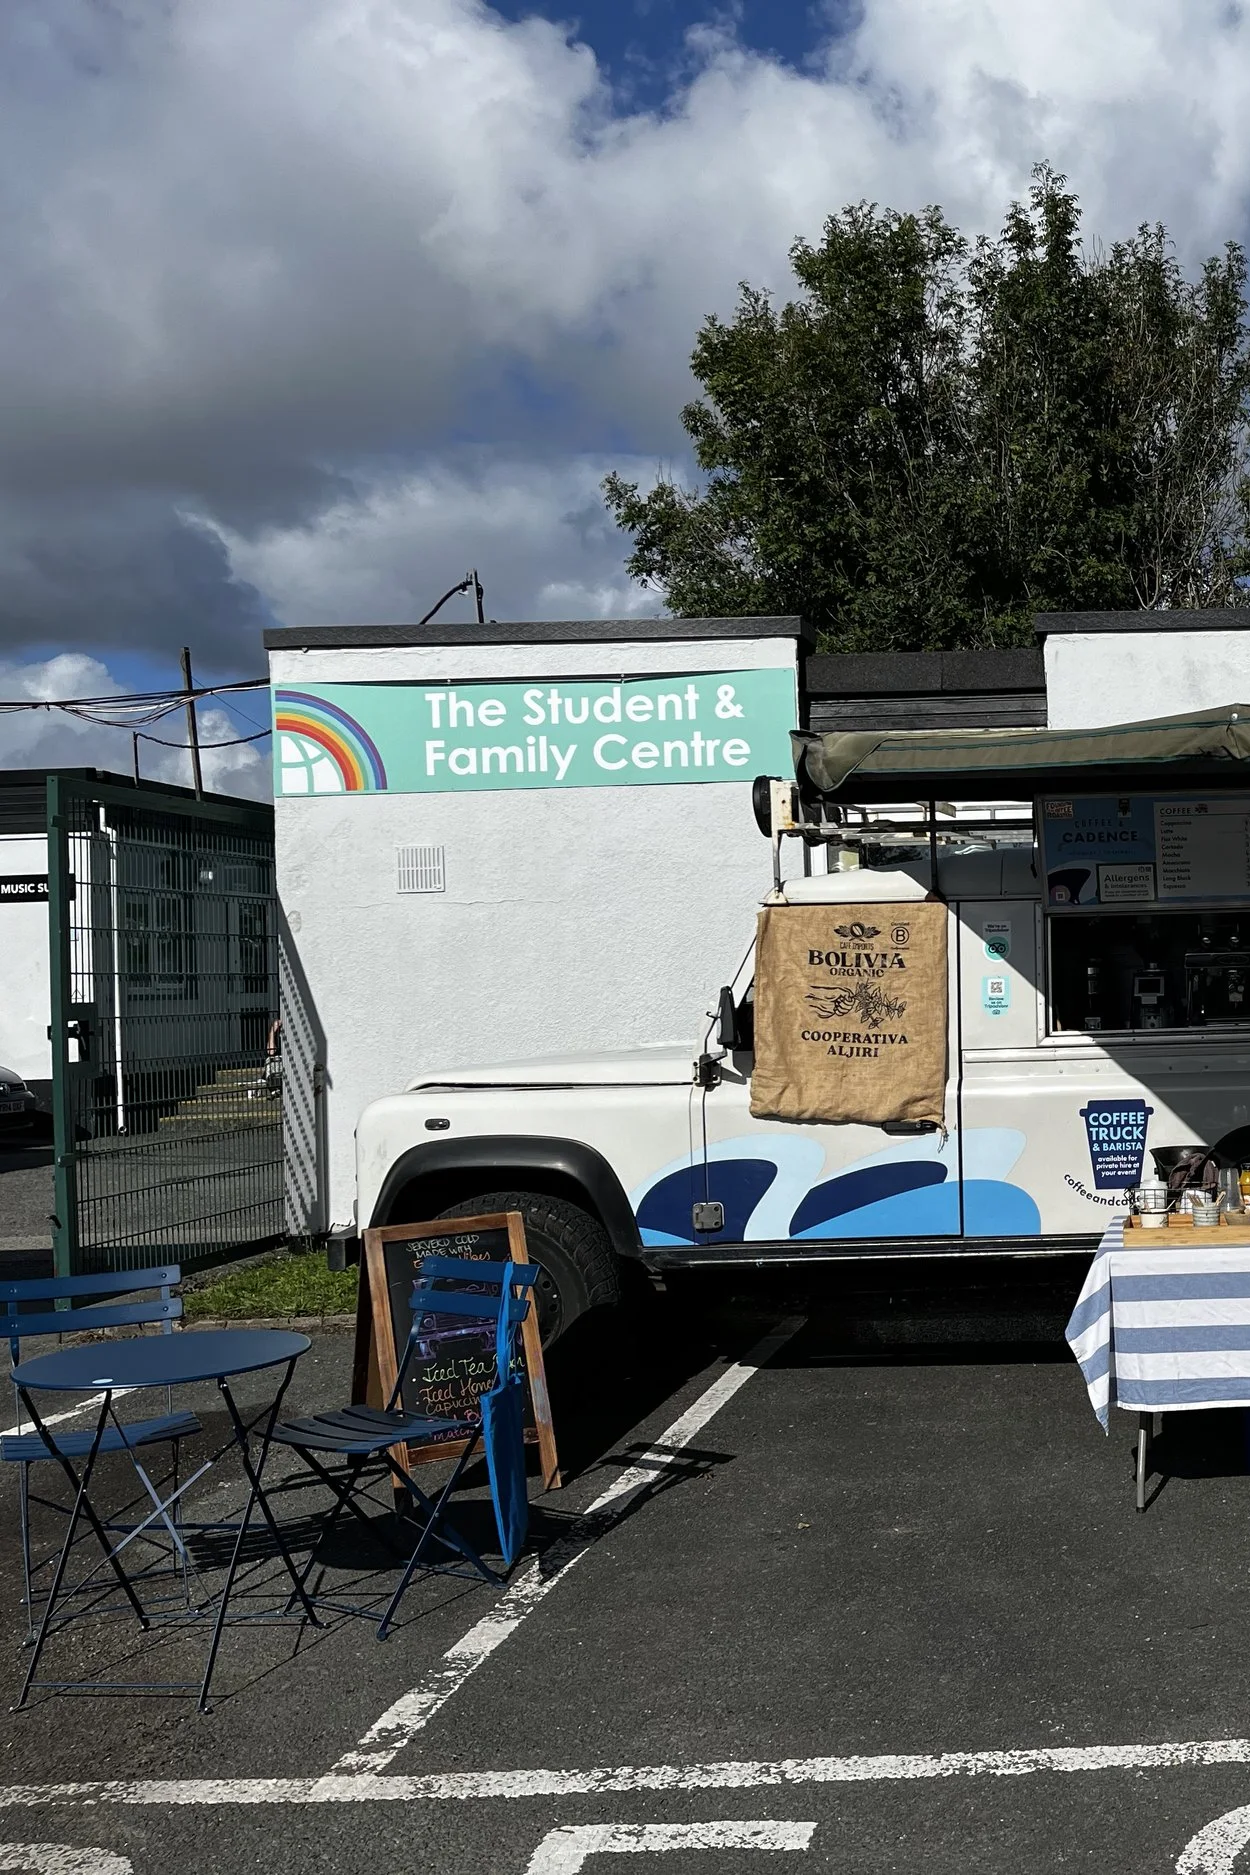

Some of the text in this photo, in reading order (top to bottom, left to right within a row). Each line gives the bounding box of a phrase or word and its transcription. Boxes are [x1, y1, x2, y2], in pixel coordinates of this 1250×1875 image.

[424, 684, 746, 732] The Student &
[426, 731, 752, 782] Family Centre
[1160, 807, 1191, 816] COFFEE
[1074, 818, 1112, 829] COFFEE
[1062, 830, 1138, 844] CADENCE
[1104, 874, 1150, 884] Allergens
[1, 884, 36, 895] MUSIC
[896, 930, 906, 942] B
[808, 950, 906, 969] BOLIVIA
[829, 968, 885, 978] ORGANIC
[801, 1030, 909, 1045] COOPERATIVA
[827, 1045, 879, 1059] ALJIRI
[1088, 1112, 1145, 1126] COFFEE
[1089, 1126, 1144, 1141] TRUCK
[1092, 1142, 1143, 1152] & BARISTA
[1097, 1155, 1128, 1163] available
[1096, 1163, 1119, 1172] private
[1119, 1162, 1132, 1170] hire
[1101, 1170, 1117, 1178] your
[455, 1234, 480, 1245] COLD
[416, 1245, 473, 1260] MADE WITH
[422, 1360, 459, 1382] Iced
[458, 1357, 495, 1376] Tea
[419, 1384, 455, 1404] Iced
